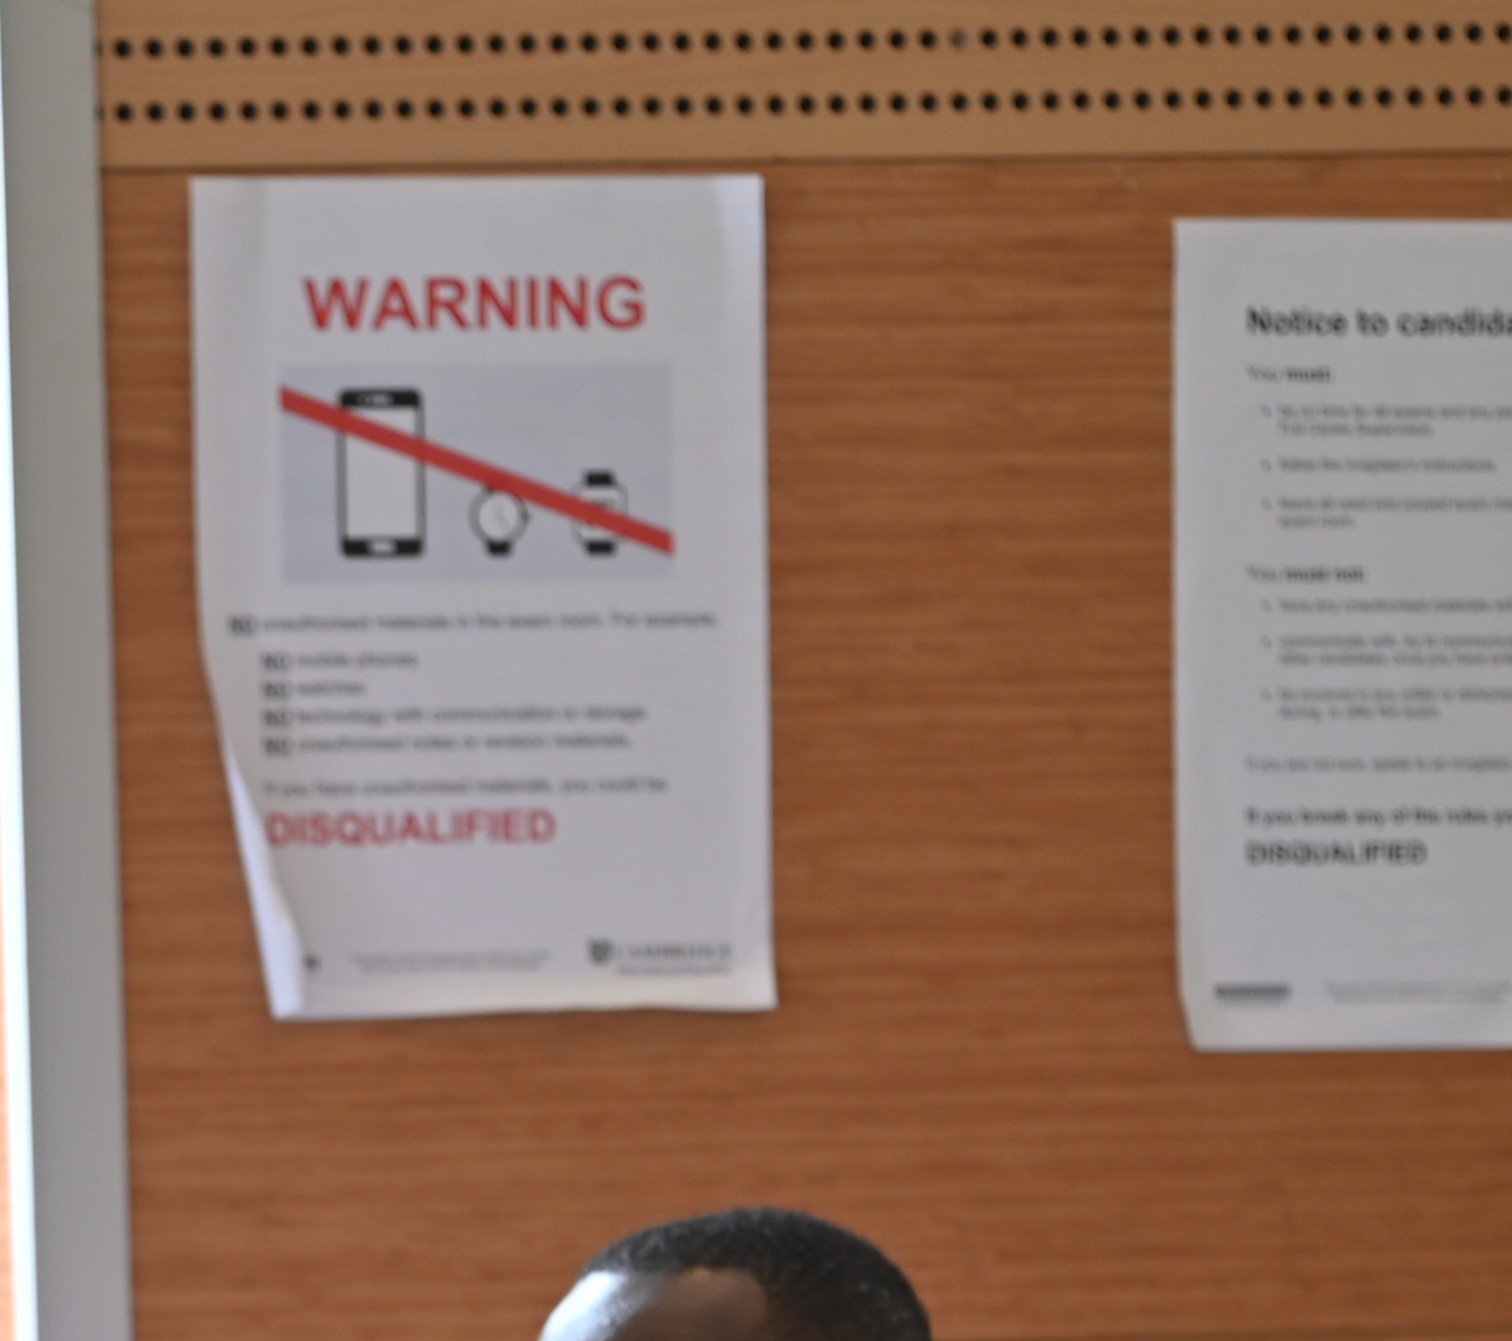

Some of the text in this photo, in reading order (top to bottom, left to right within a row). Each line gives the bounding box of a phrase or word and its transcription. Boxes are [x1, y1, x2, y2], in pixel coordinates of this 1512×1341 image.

[303, 276, 647, 331] WARNING
[1246, 306, 1349, 337] Notice
[1356, 307, 1389, 337] to
[264, 809, 559, 847] DISQUALIFIED
[1244, 838, 1429, 867] DISQUALIFIED
